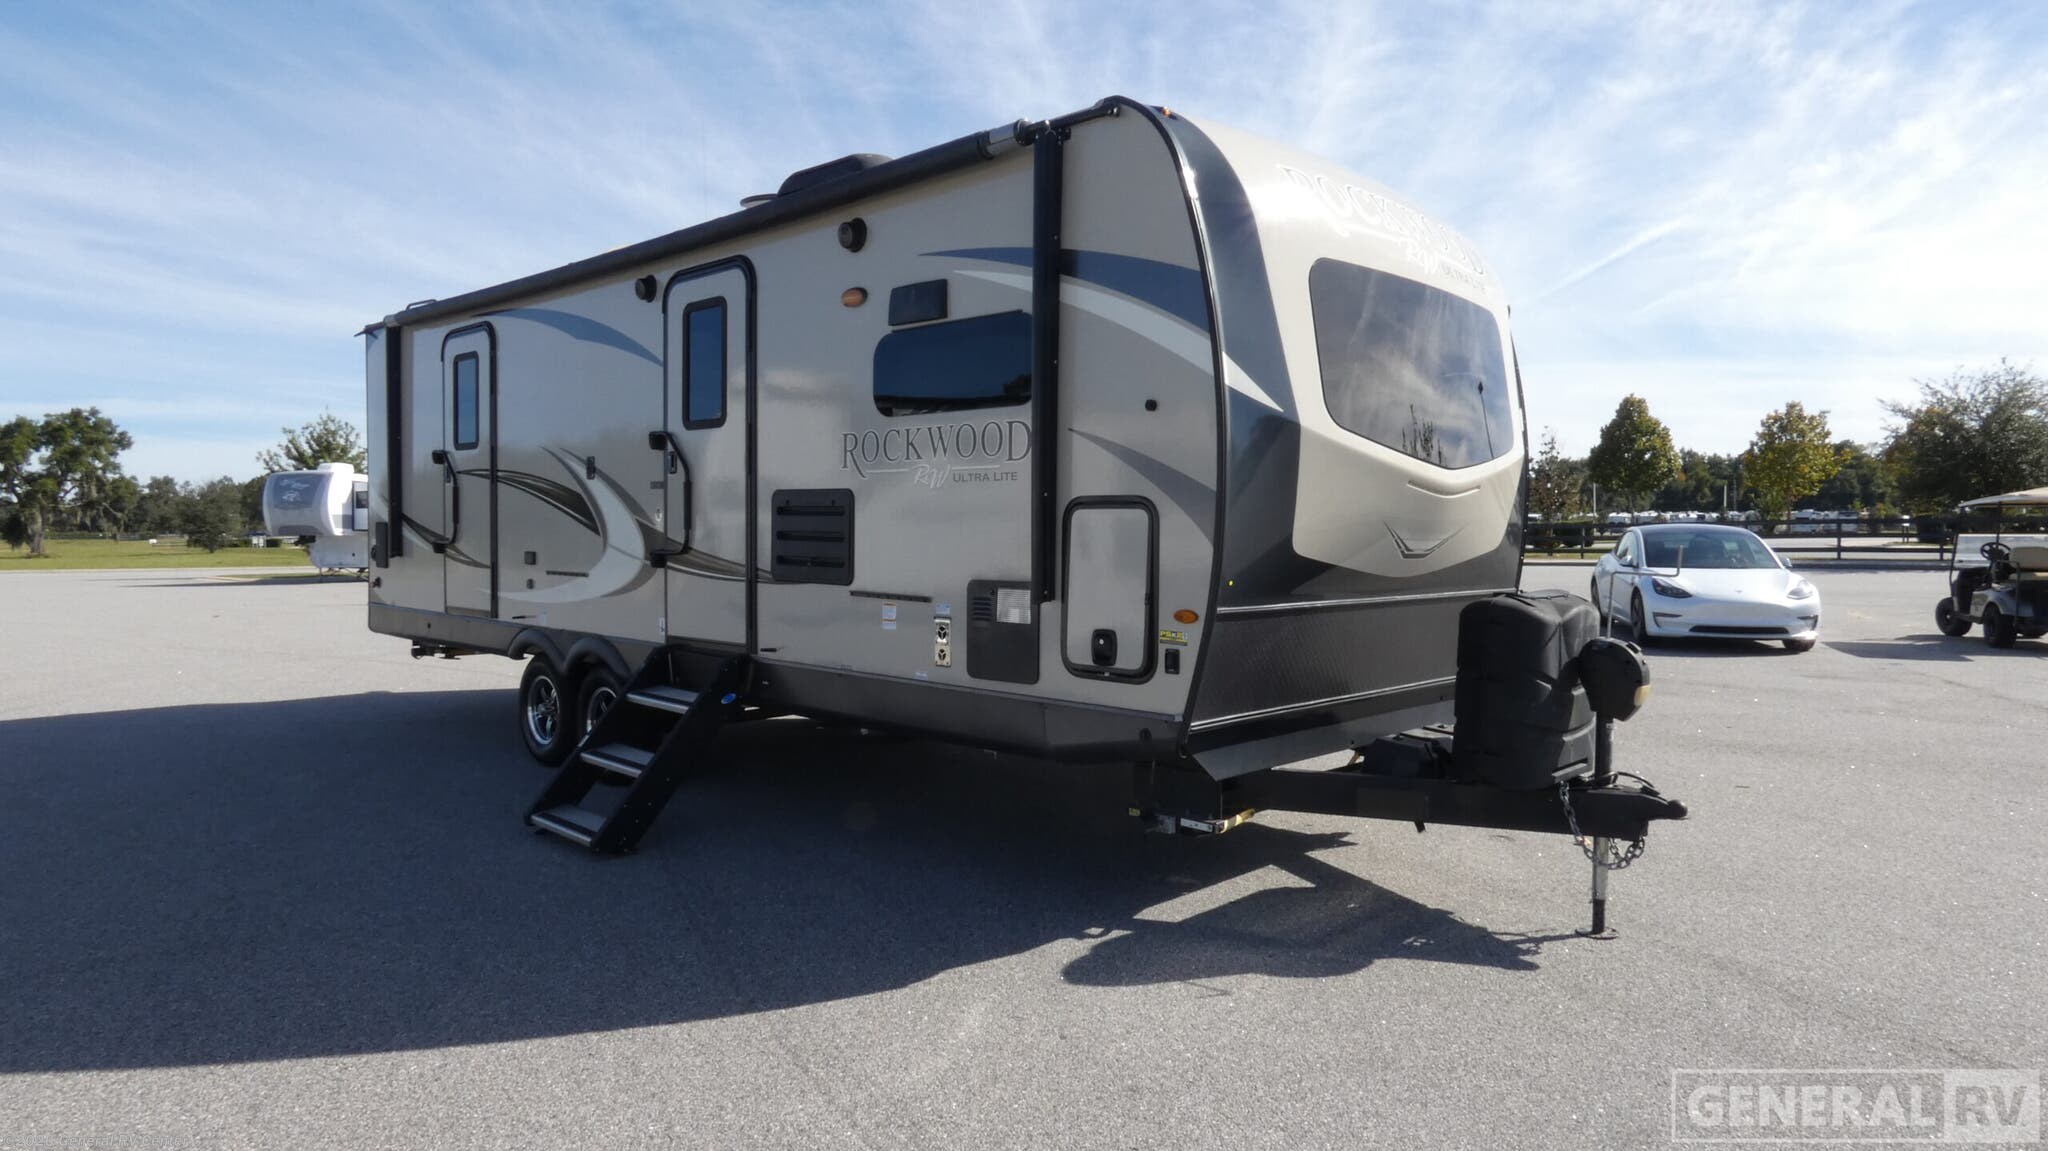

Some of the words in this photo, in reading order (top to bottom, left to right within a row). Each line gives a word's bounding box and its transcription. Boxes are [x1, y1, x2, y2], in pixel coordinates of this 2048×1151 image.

[840, 420, 1032, 478] ROCKWOOD
[953, 472, 990, 483] ULTRA
[993, 471, 1018, 482] LITE
